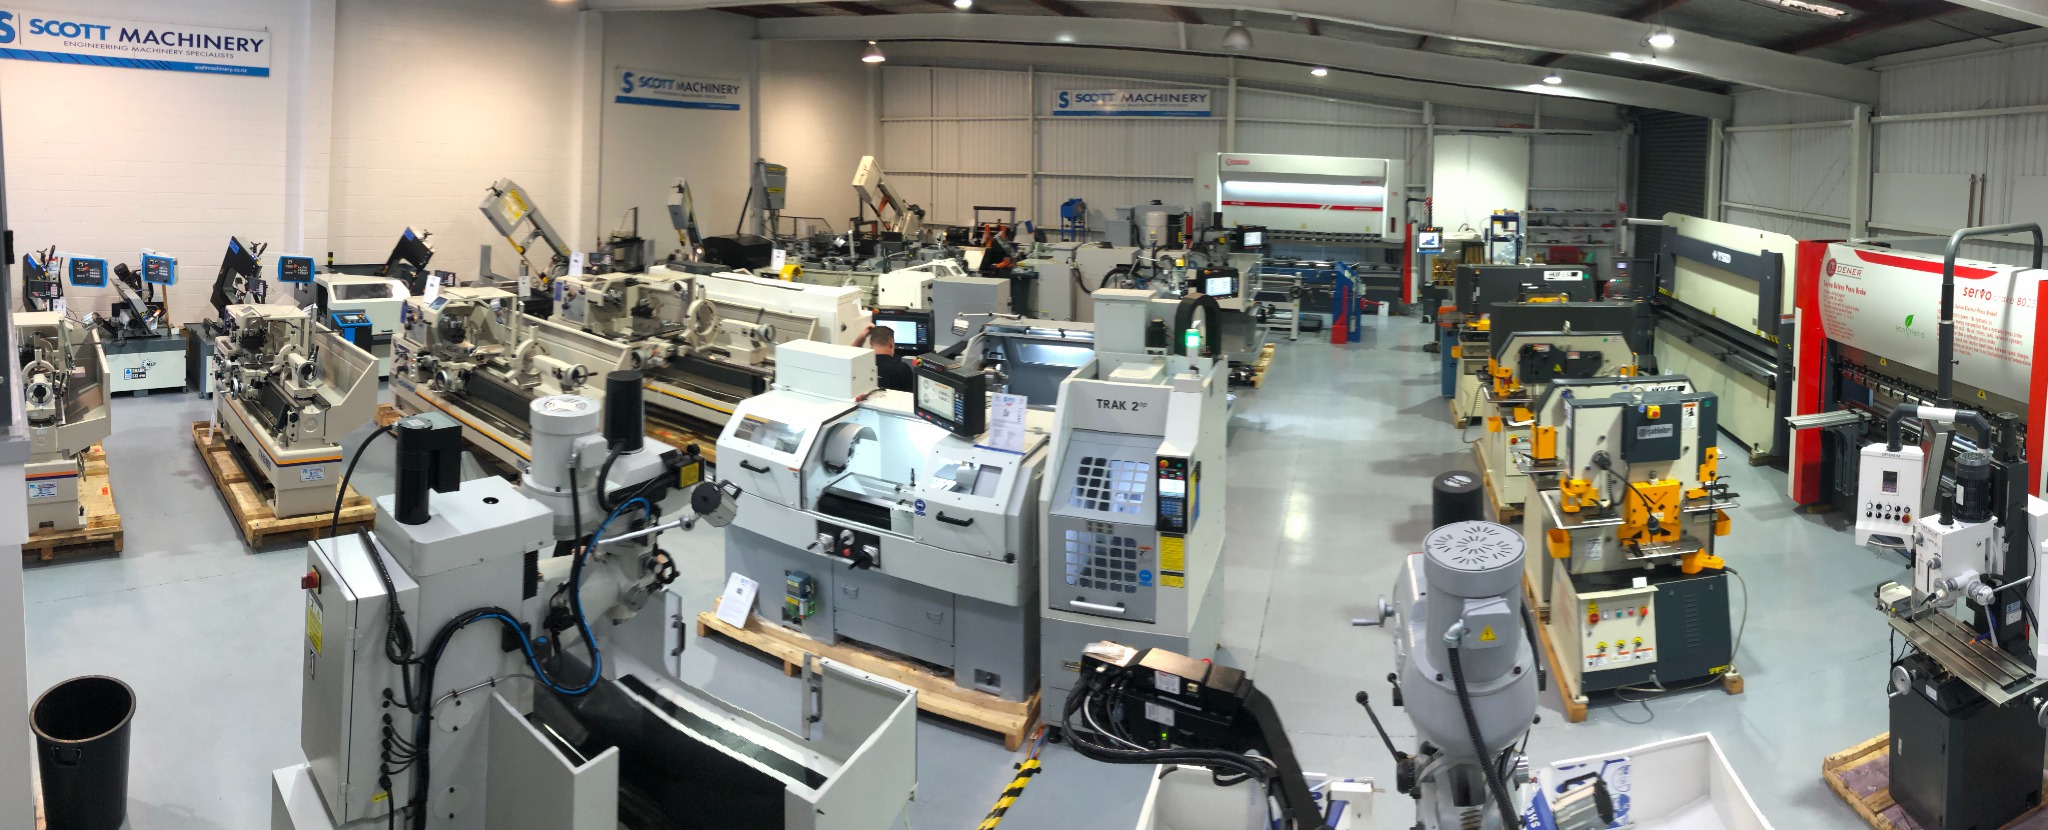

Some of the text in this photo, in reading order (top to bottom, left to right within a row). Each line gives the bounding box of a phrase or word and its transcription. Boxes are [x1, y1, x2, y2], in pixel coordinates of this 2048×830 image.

[29, 18, 264, 53] SCOTT MACHINERY
[63, 40, 235, 59] ENGINEERING MACHINERY SPECIALISTS
[638, 76, 675, 90] SCOTT
[675, 81, 740, 95] MACHINERY
[1075, 93, 1209, 103] SCOTT MACHINERY
[1836, 265, 1863, 277] DENER
[1962, 287, 1992, 301] servo
[1096, 398, 1127, 411] TRAK
